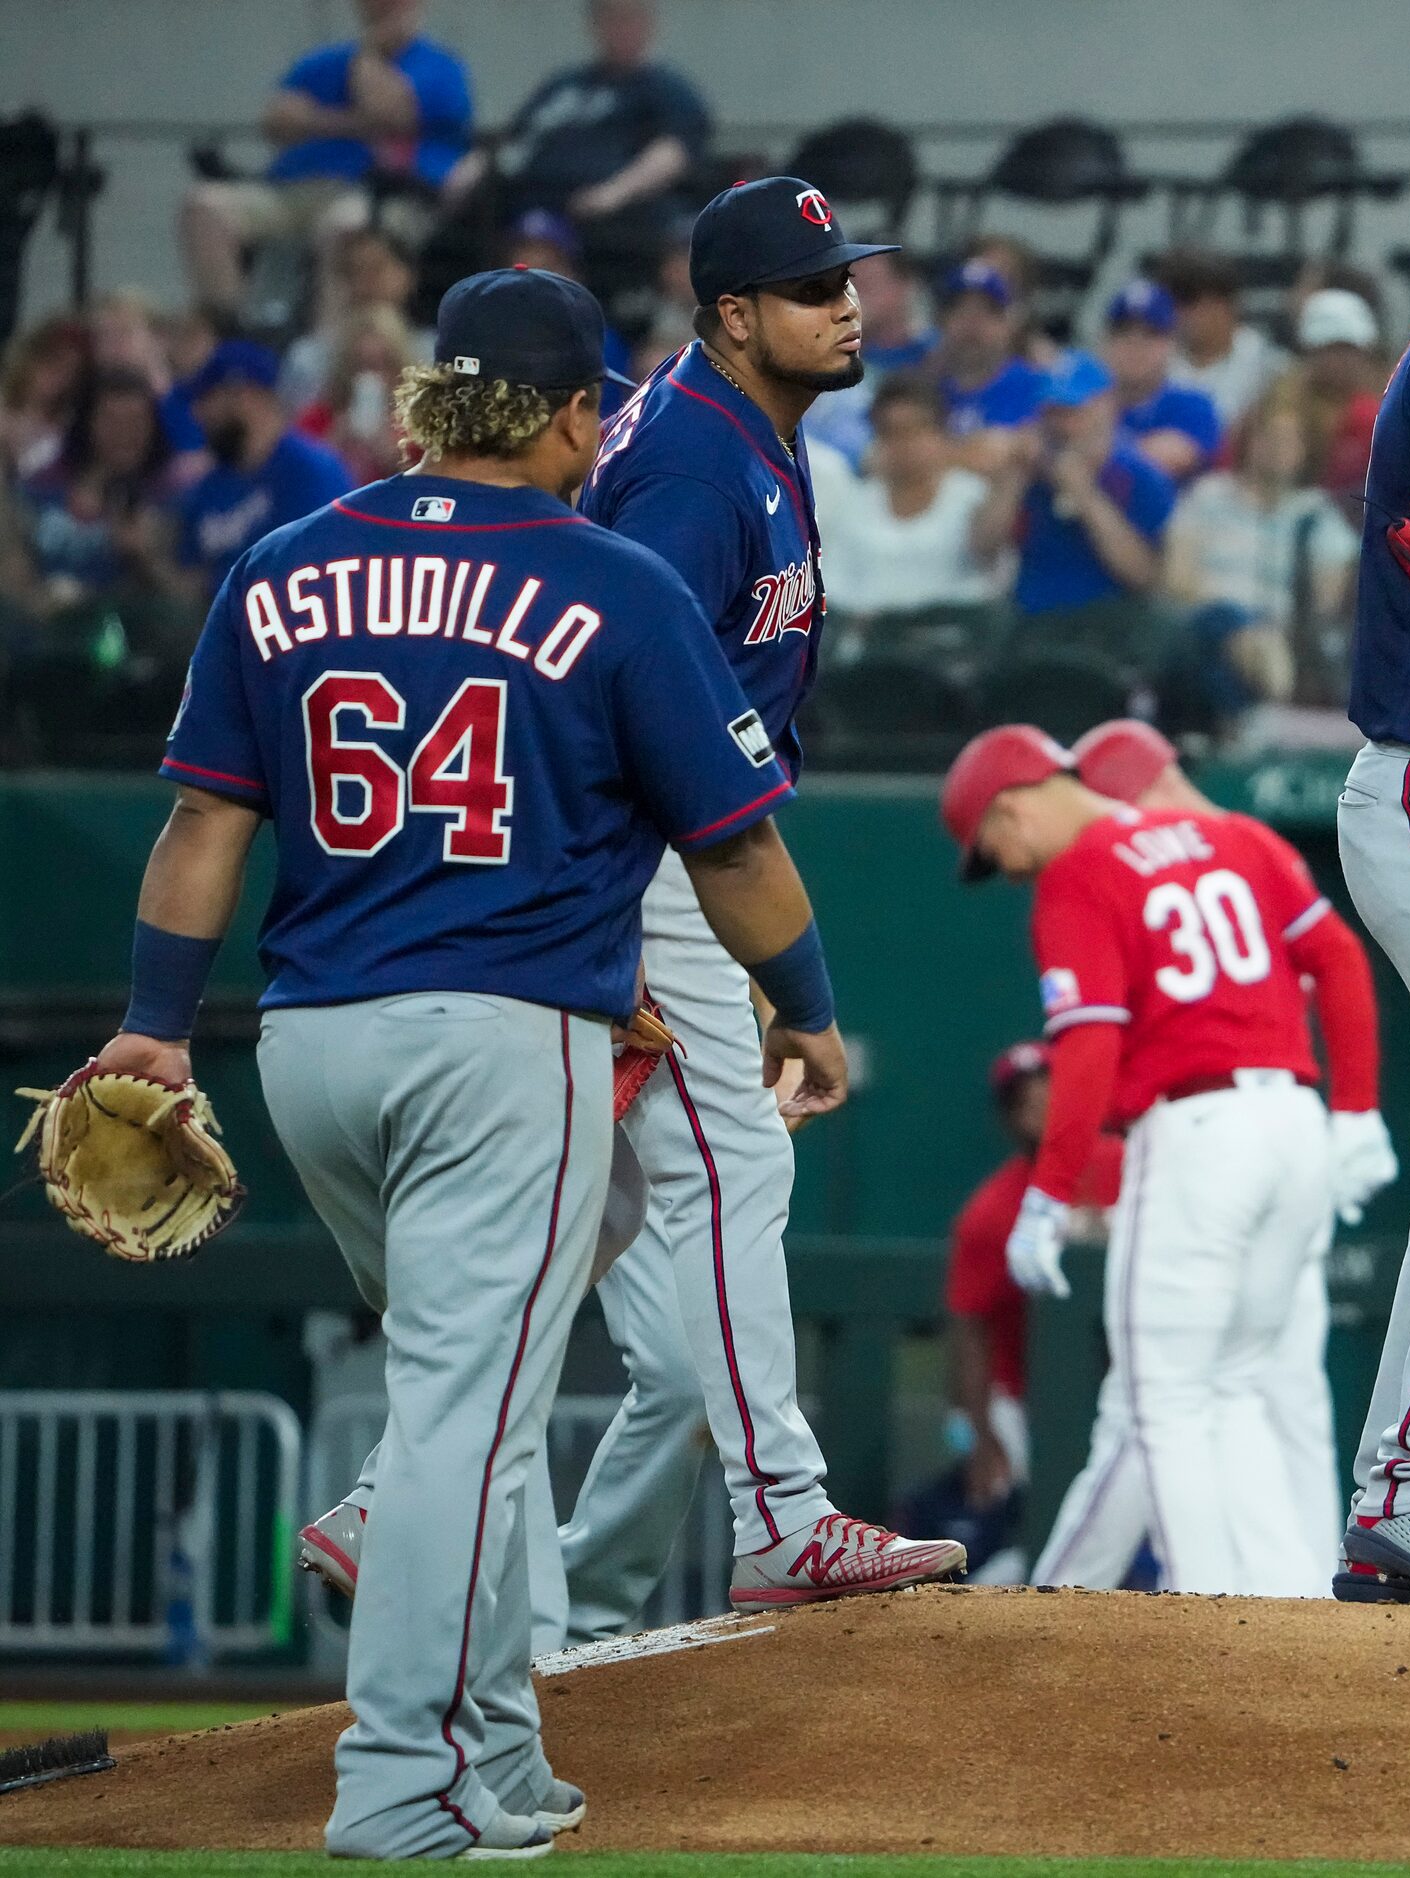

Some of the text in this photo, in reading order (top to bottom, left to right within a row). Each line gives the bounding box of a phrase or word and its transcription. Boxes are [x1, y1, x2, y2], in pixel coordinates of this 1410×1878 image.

[245, 556, 602, 682] ASTUDILLO
[301, 669, 515, 865] 64
[1142, 867, 1272, 1004] 30
